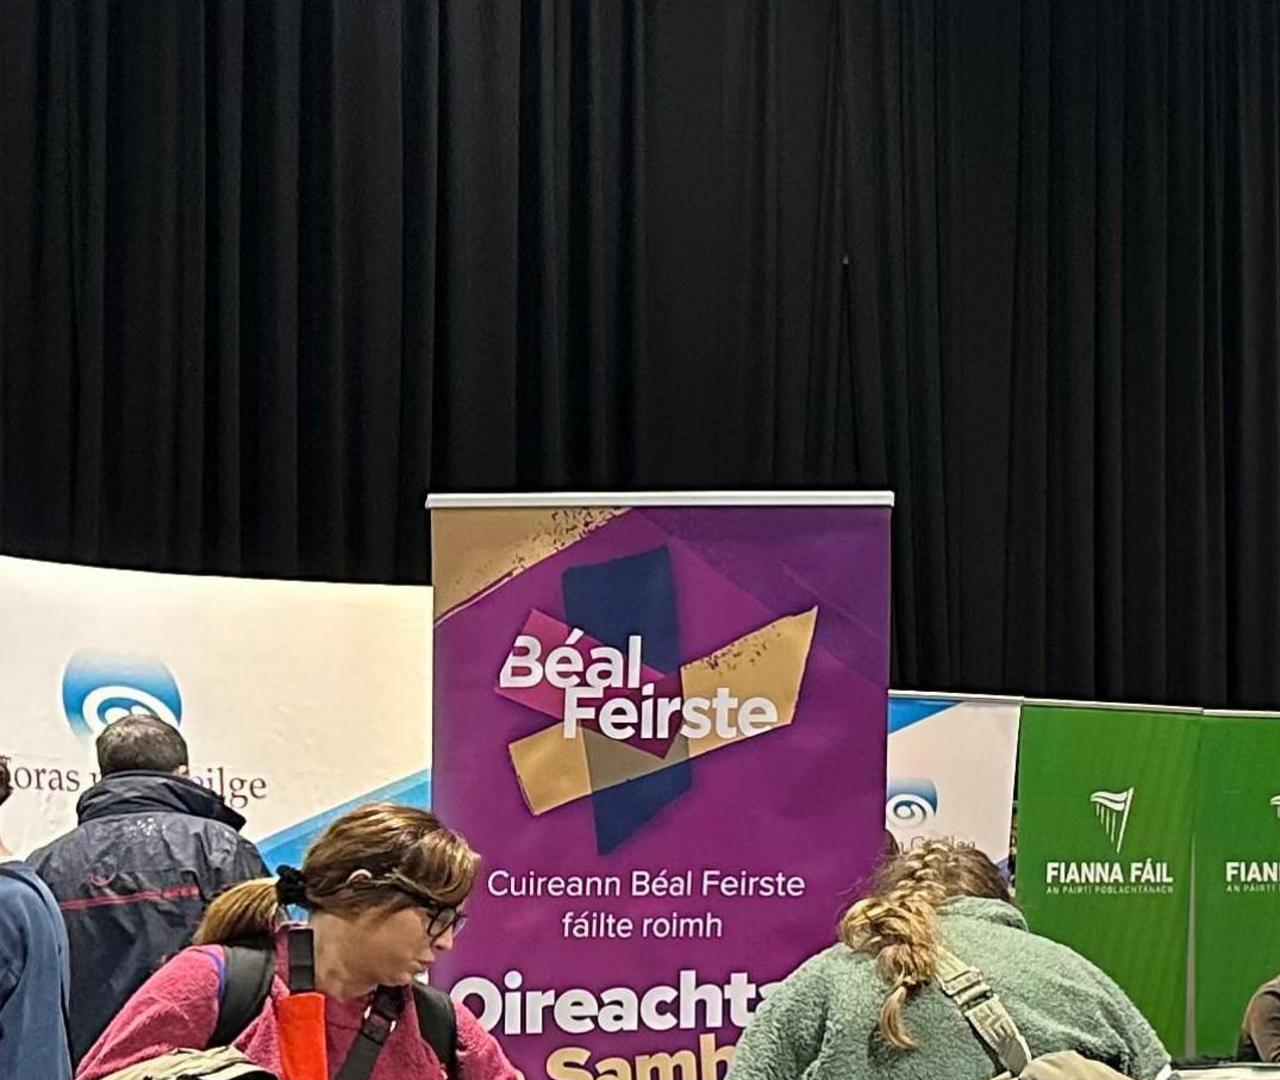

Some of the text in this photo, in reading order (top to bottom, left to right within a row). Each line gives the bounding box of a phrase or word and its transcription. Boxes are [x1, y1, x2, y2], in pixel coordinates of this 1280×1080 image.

[500, 627, 642, 690] Béal
[564, 682, 778, 741] Feirste
[9, 764, 80, 793] oras
[487, 868, 806, 897] Cuireann Béal Feirste
[1046, 857, 1174, 884] FIANNA FÁIL
[1226, 884, 1241, 893] AN
[562, 911, 723, 938] fáilte roimh
[450, 970, 783, 1036] Oireacht
